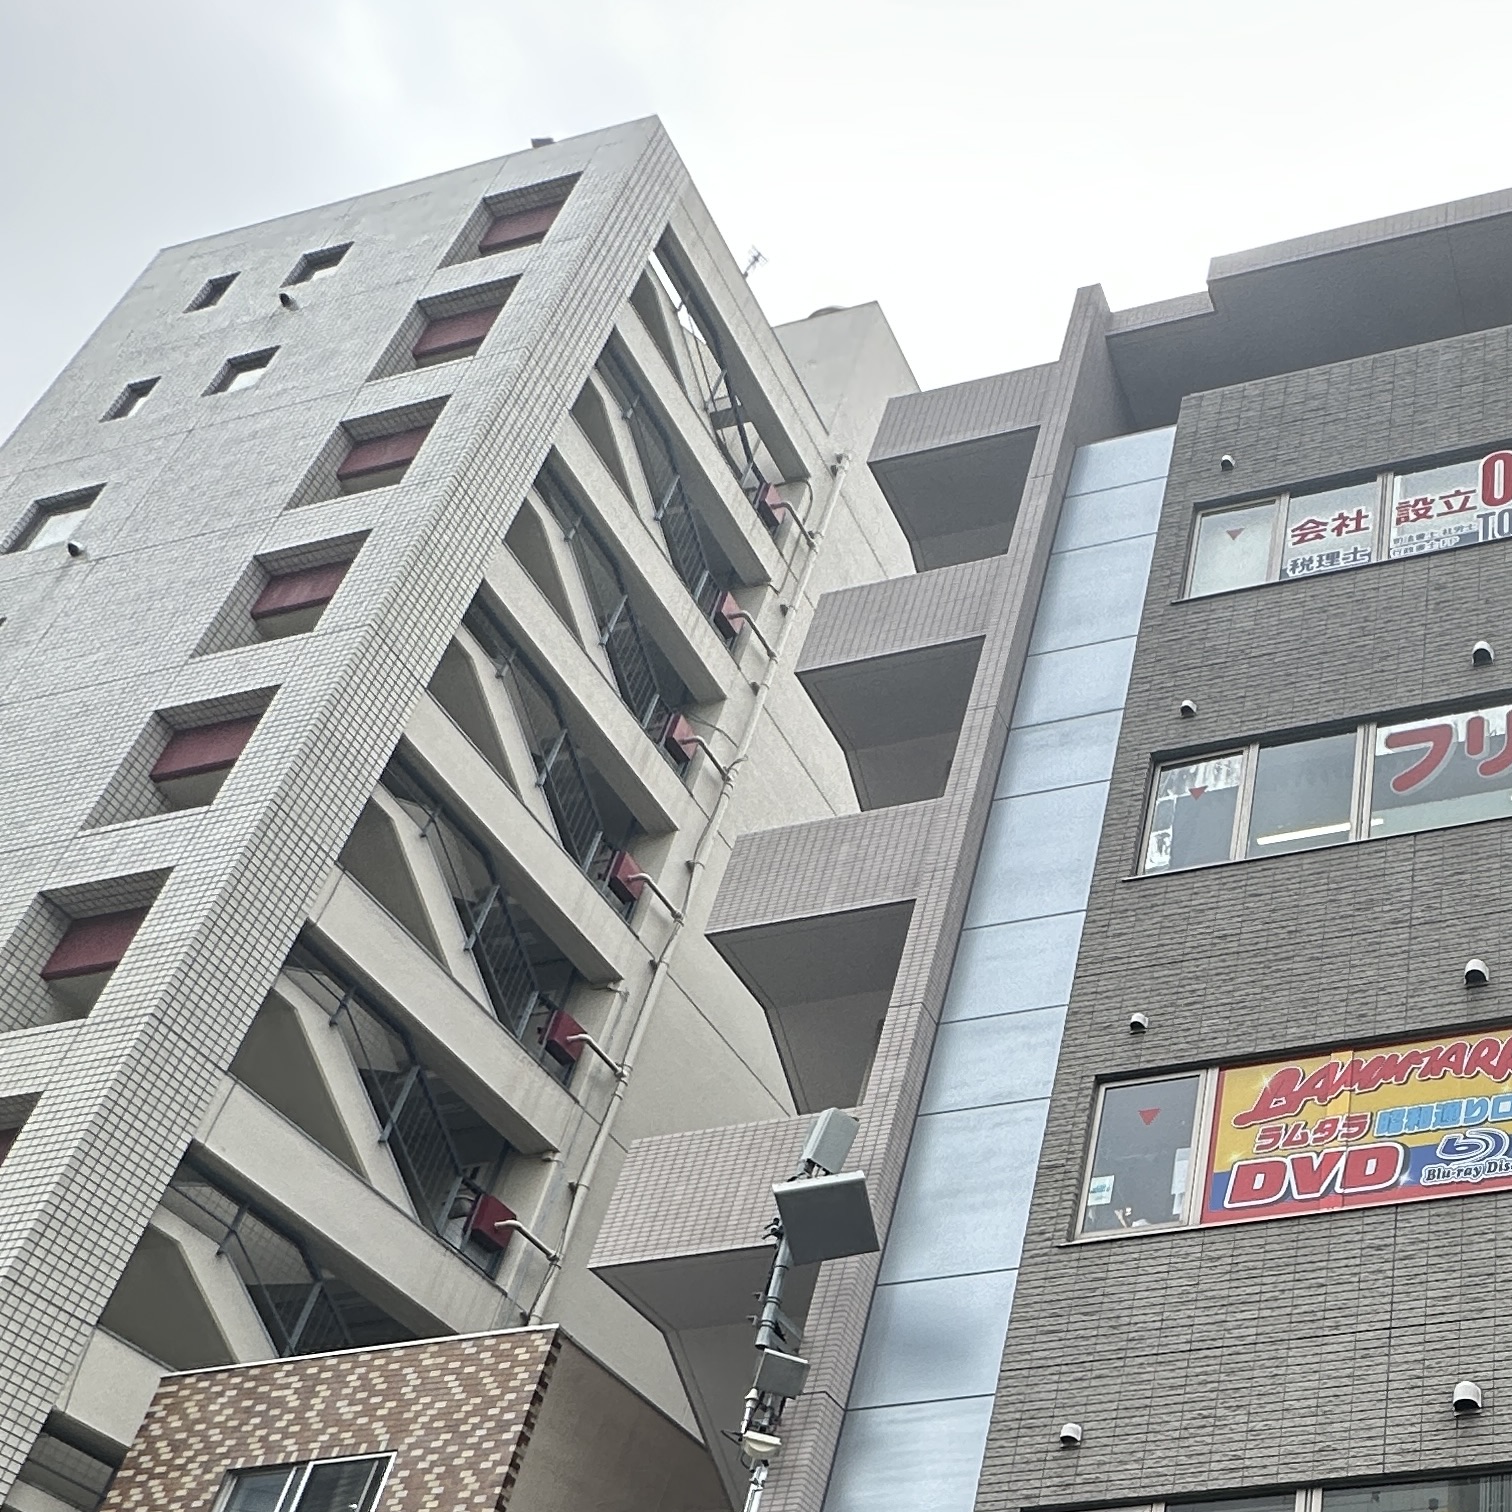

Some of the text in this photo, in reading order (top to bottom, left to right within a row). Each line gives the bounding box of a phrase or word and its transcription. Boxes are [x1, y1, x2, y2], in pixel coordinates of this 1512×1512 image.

[1291, 508, 1370, 546] 会社
[1289, 546, 1371, 574] 税理士
[1254, 1112, 1371, 1152] ラムタラ
[1224, 1143, 1404, 1208] DVD
[1425, 1161, 1484, 1182] Blu-ray
